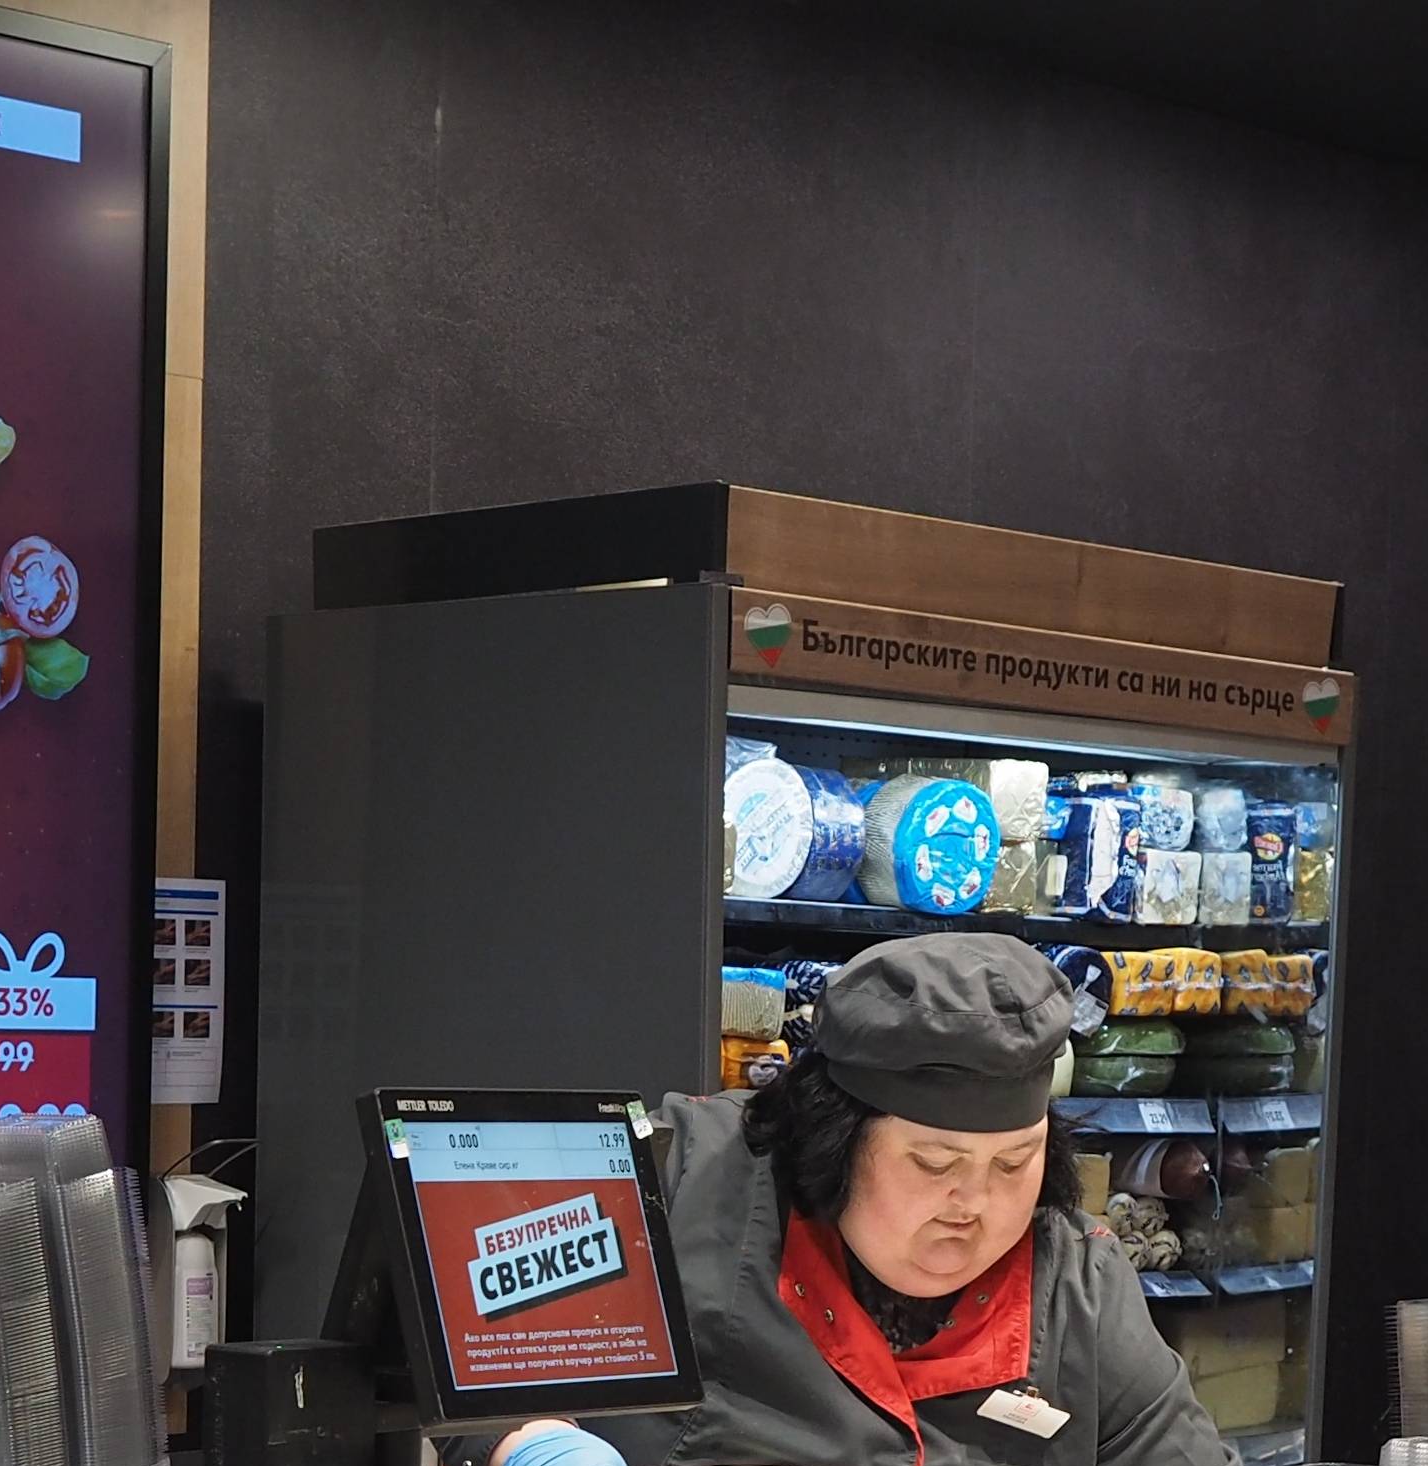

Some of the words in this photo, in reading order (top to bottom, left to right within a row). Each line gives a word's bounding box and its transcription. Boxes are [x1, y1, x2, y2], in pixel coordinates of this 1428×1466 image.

[803, 619, 976, 672] Българските
[986, 654, 1108, 690] продукти
[1117, 671, 1143, 692] са
[1152, 675, 1180, 698] ни
[1189, 680, 1217, 702] на
[1225, 685, 1294, 717] сърце
[449, 1134, 479, 1148] 0.000
[599, 1133, 625, 1148] 12.99
[610, 1159, 631, 1173] 0.00
[485, 1206, 592, 1255] БЕЗУПРЕЧНА
[480, 1230, 608, 1300] СВЕЖЕСТ
